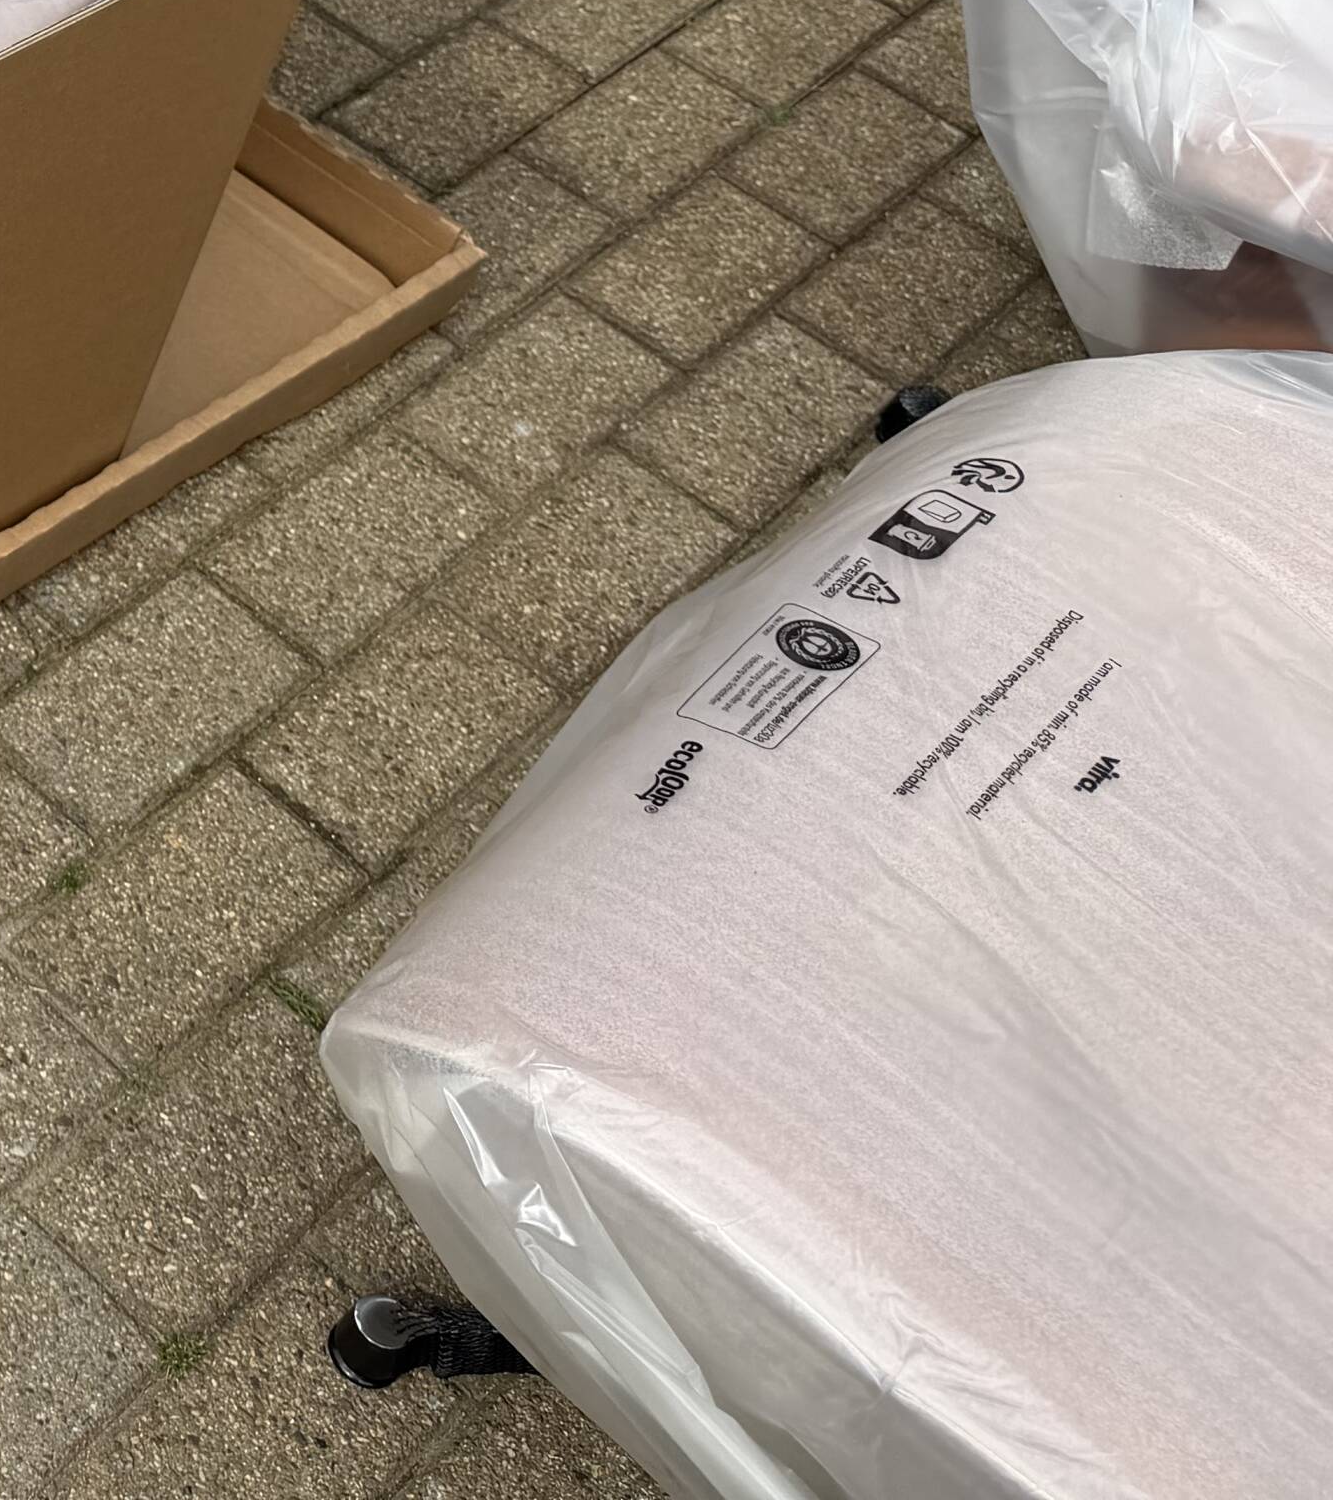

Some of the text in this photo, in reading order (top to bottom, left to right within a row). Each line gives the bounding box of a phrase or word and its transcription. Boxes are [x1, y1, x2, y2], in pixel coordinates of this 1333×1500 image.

[1040, 610, 1083, 651] Disposed
[1023, 657, 1040, 666] in
[1032, 648, 1045, 661] of
[1096, 663, 1113, 677] am
[981, 671, 1021, 712] recycling
[1074, 676, 1101, 701] made
[1048, 711, 1069, 729] min.
[1066, 701, 1078, 716] of
[955, 719, 972, 739] am
[1031, 729, 1055, 751] 85%
[935, 734, 963, 758] 100%
[893, 752, 939, 795] recyclable.
[1001, 747, 1036, 784] recycled
[966, 778, 1006, 820] material.
